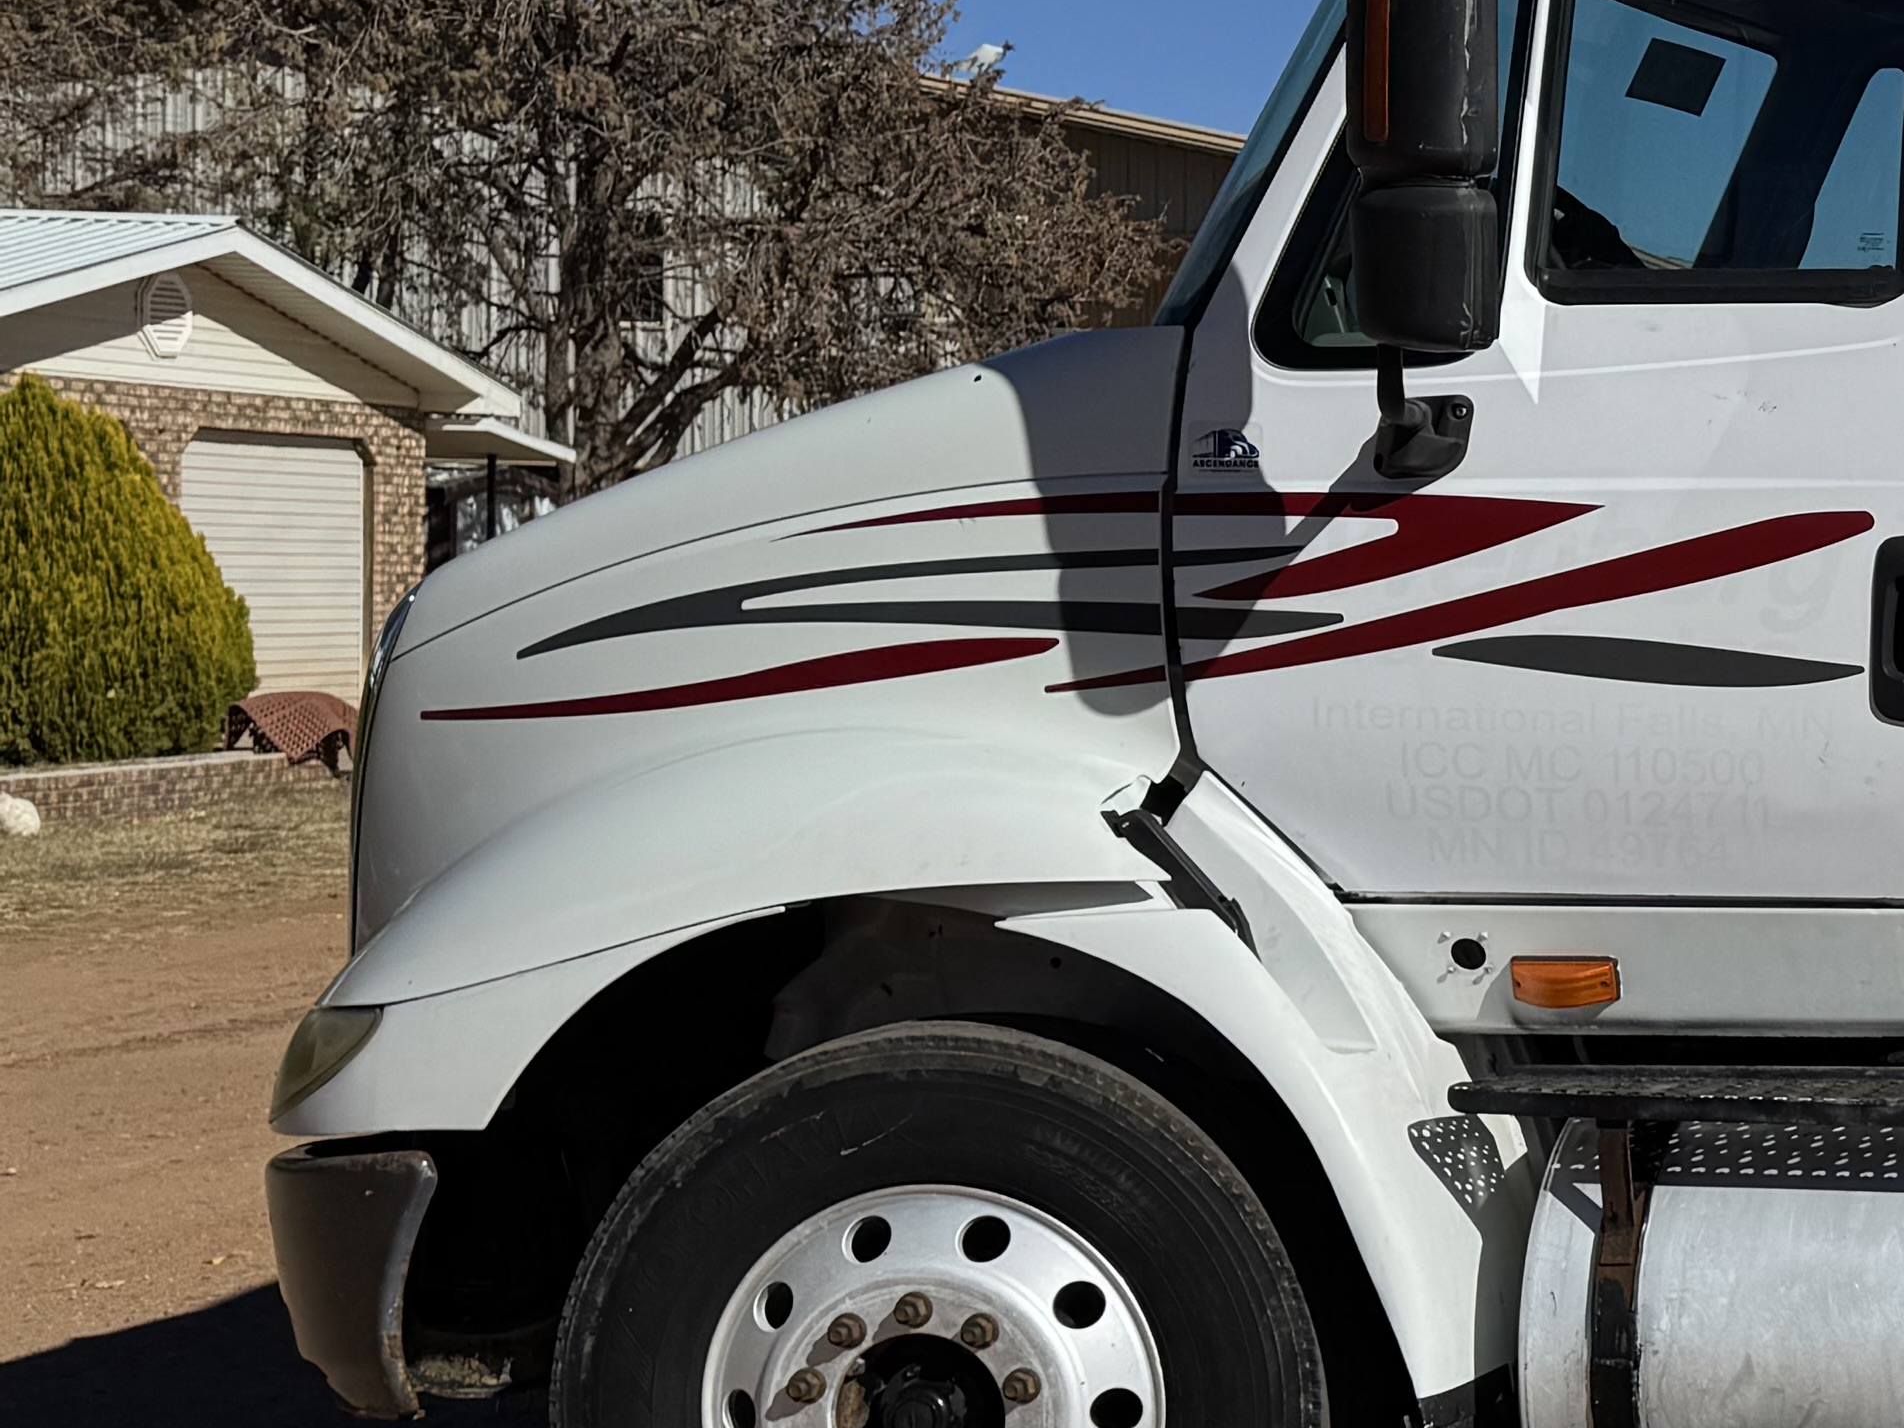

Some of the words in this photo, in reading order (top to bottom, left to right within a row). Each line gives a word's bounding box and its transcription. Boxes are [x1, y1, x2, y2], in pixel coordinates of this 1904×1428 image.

[1311, 695, 1596, 738] International
[1400, 739, 1487, 779] ICC
[1505, 742, 1583, 782] MC
[1608, 746, 1767, 787] 110500
[1582, 788, 1772, 830] 0124711
[1427, 827, 1504, 866] MN
[1526, 829, 1571, 867] ID
